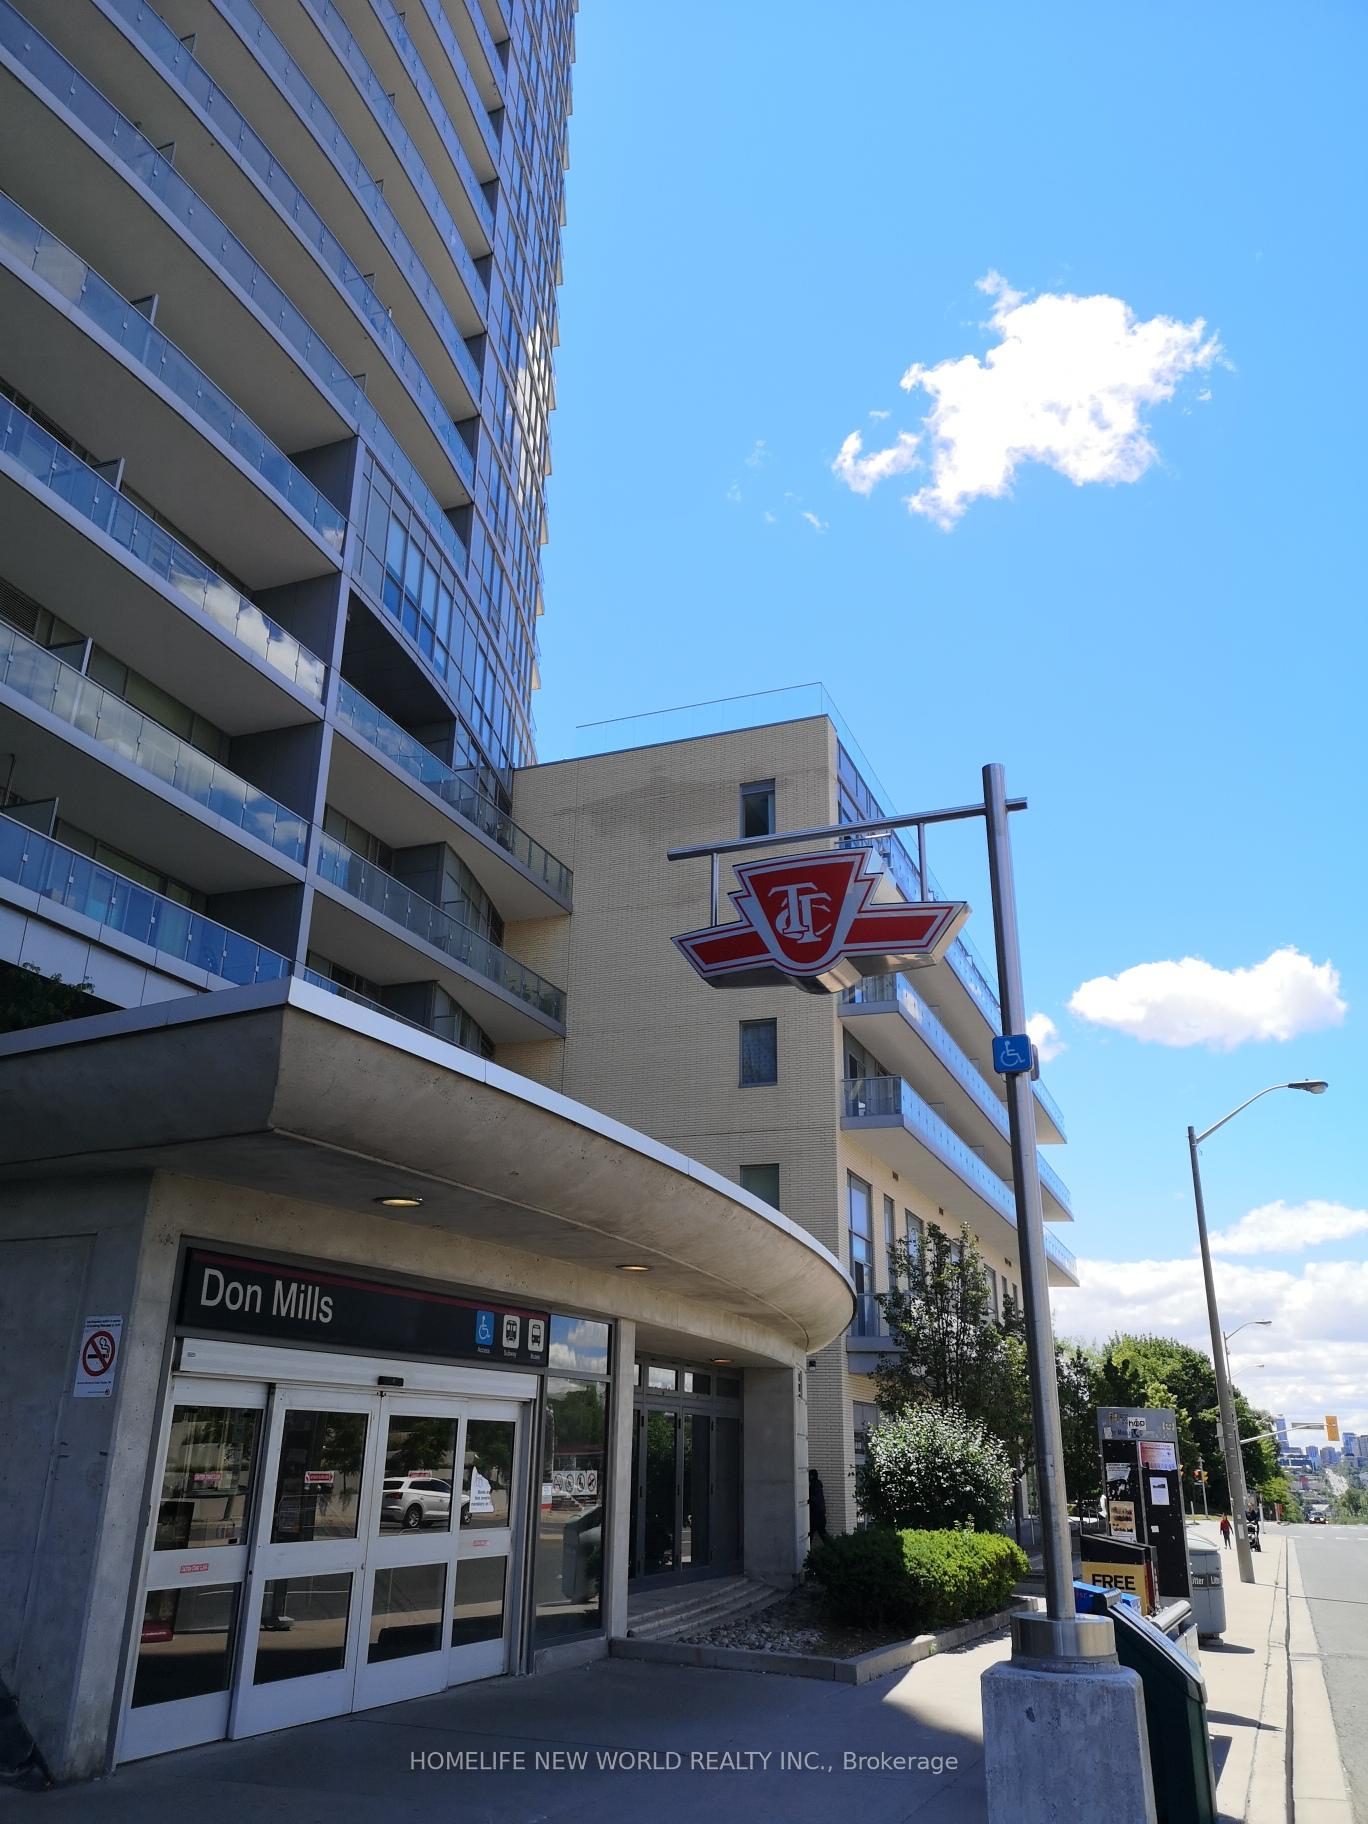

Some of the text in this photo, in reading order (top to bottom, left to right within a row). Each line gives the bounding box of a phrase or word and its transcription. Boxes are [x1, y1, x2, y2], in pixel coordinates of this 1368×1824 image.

[200, 1267, 334, 1324] Don Mills
[1092, 1573, 1136, 1591] FREE
